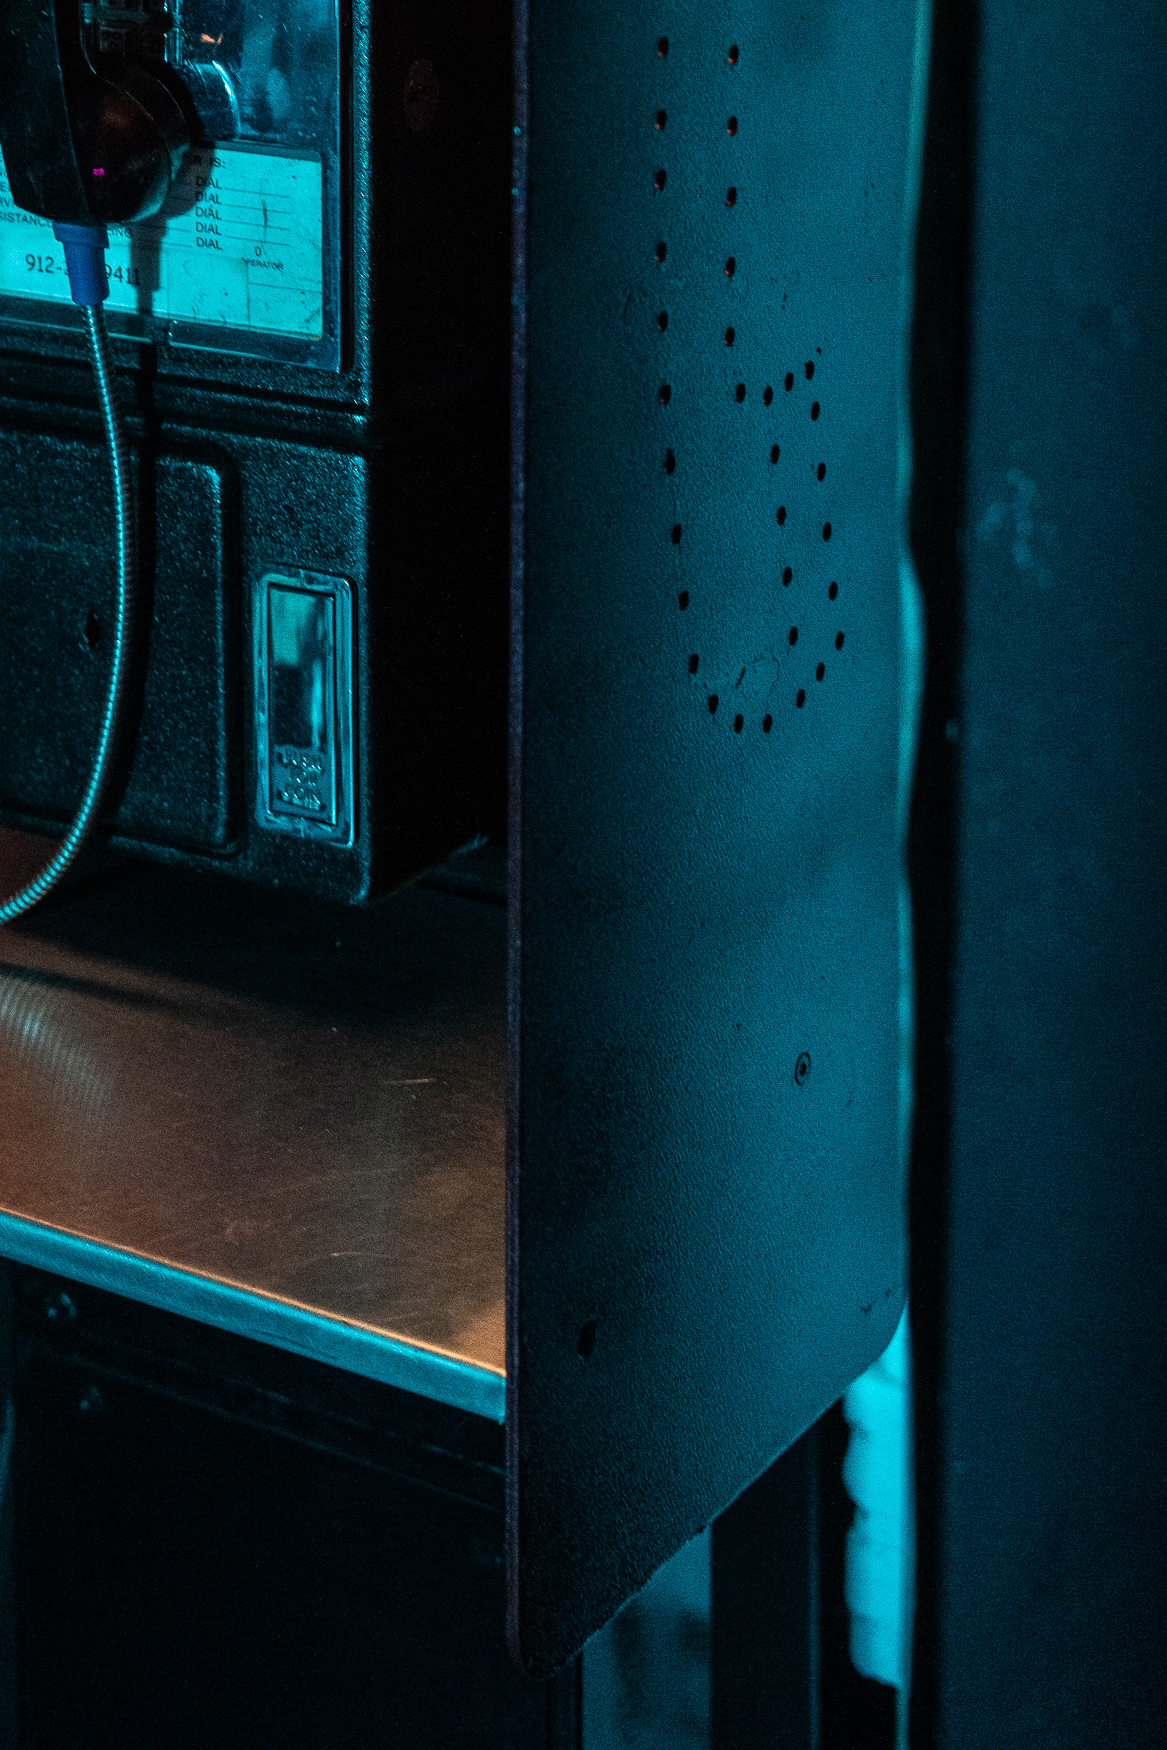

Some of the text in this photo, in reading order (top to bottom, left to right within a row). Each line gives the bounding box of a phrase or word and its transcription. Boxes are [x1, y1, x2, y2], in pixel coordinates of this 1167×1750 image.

[195, 176, 223, 190] DIAL
[195, 191, 223, 205] DIAL
[195, 206, 222, 220] DIAL
[195, 221, 223, 235] DIAL
[196, 236, 224, 250] DIAL
